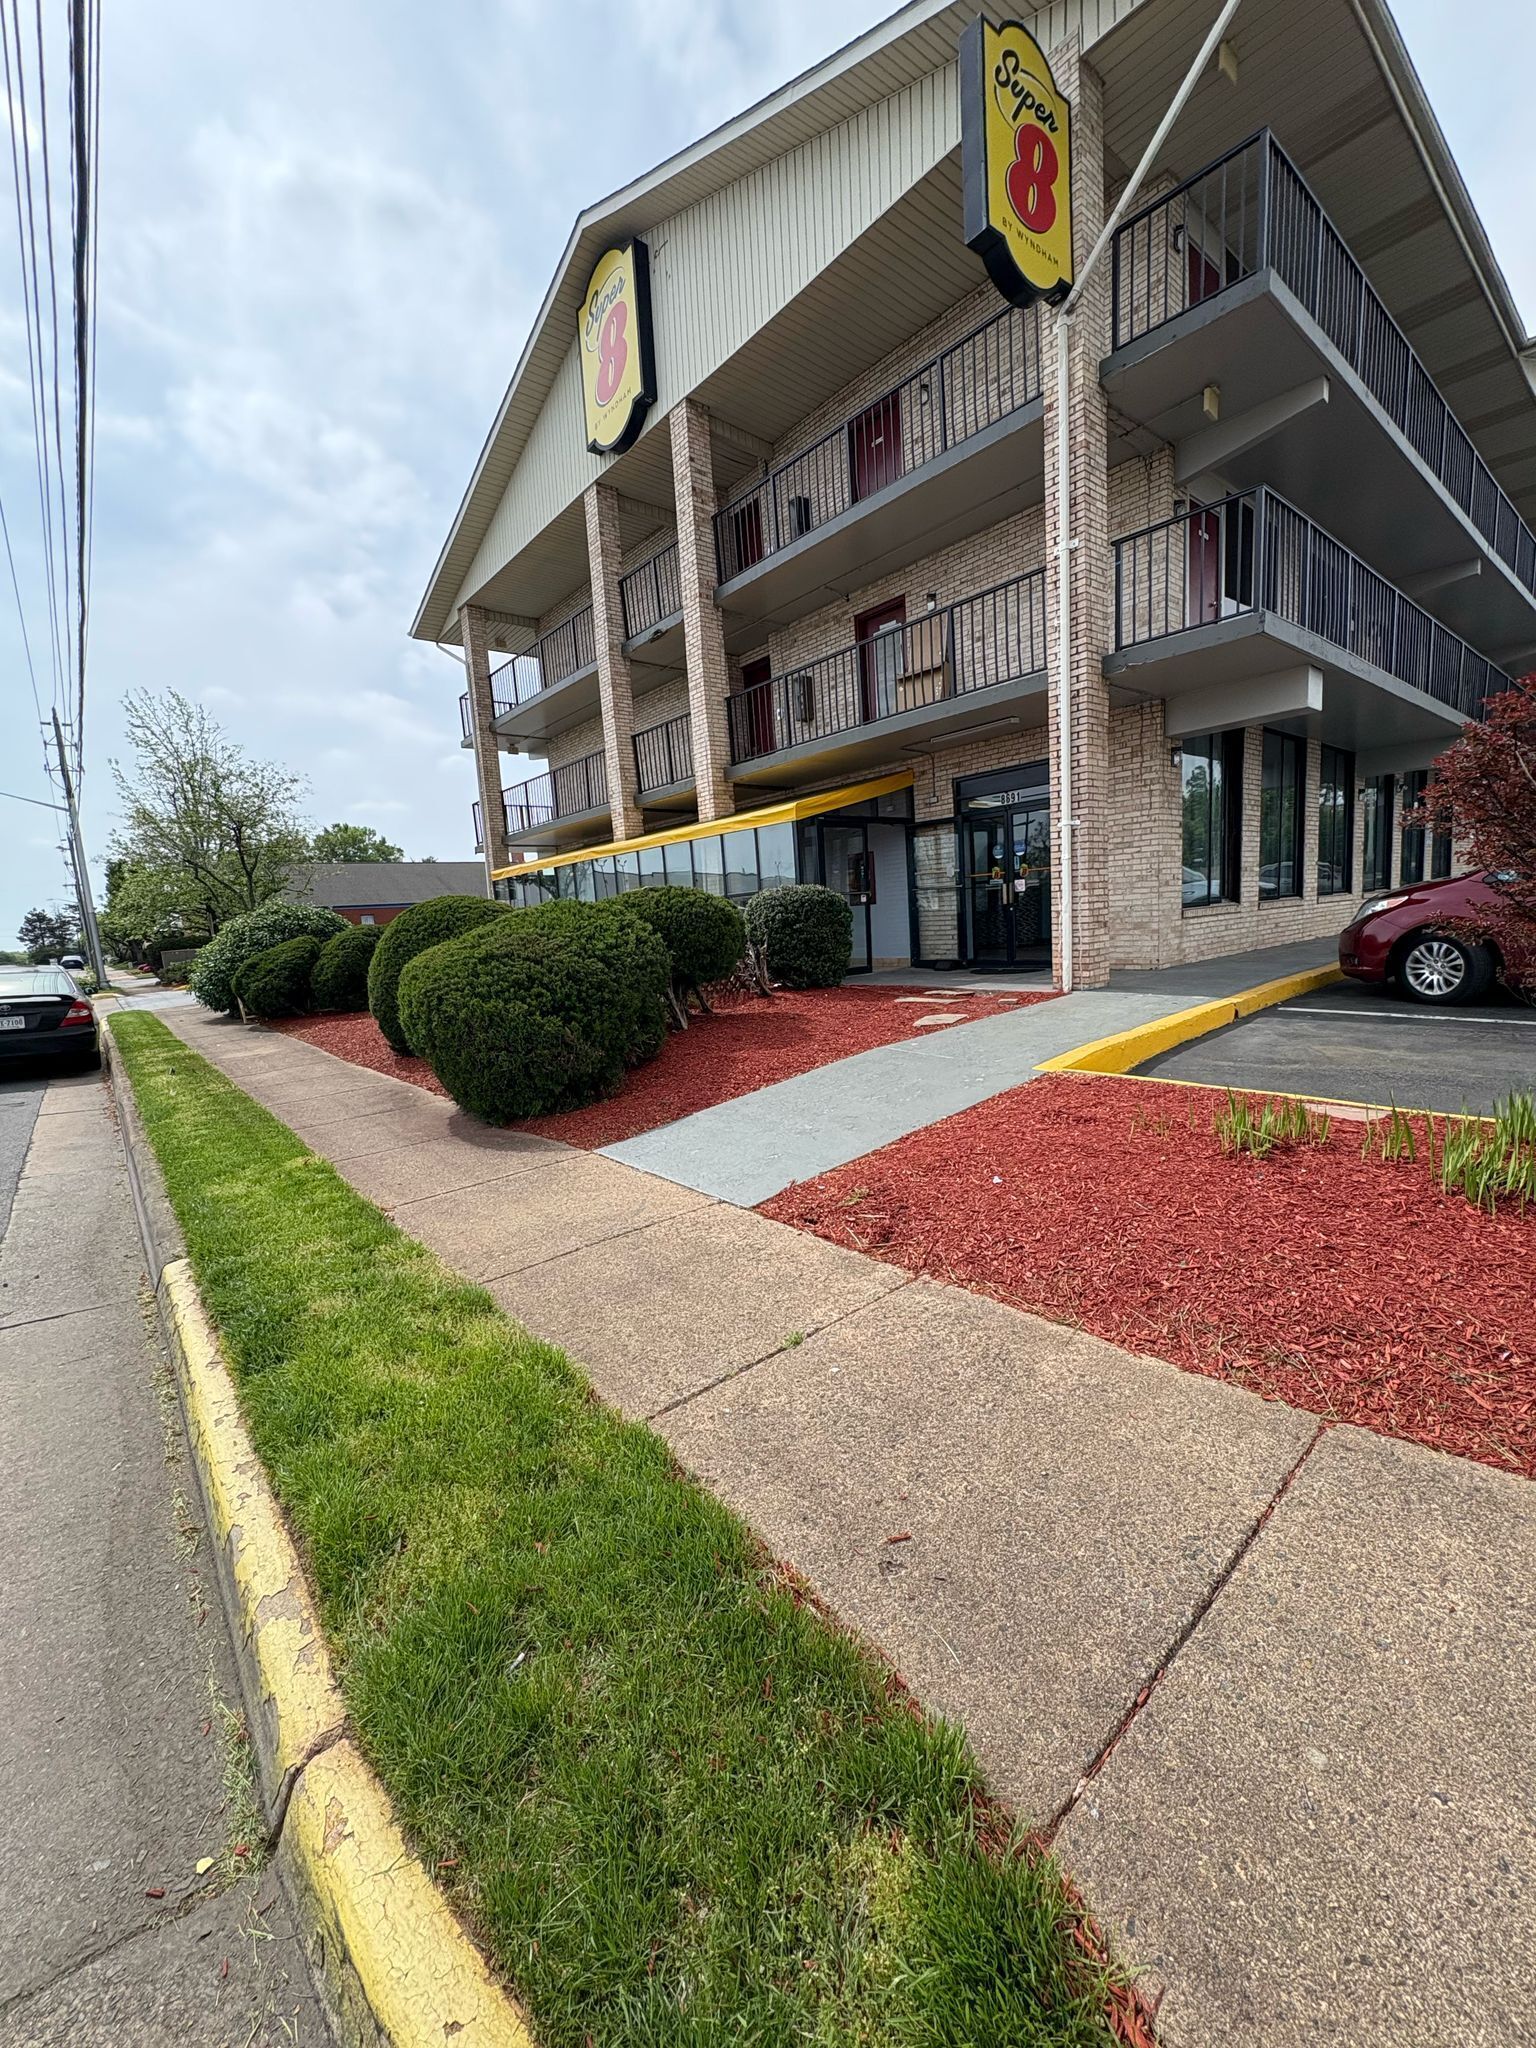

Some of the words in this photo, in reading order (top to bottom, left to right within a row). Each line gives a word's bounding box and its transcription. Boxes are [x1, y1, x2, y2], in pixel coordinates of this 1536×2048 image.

[995, 49, 1058, 133] Super
[1006, 123, 1059, 234] 8
[1002, 217, 1012, 231] BY
[1016, 228, 1059, 268] WYNDHAM
[586, 276, 626, 340] Super
[596, 300, 628, 407] 8
[603, 387, 632, 421] WYNDHAM
[1001, 792, 1019, 804] 8691
